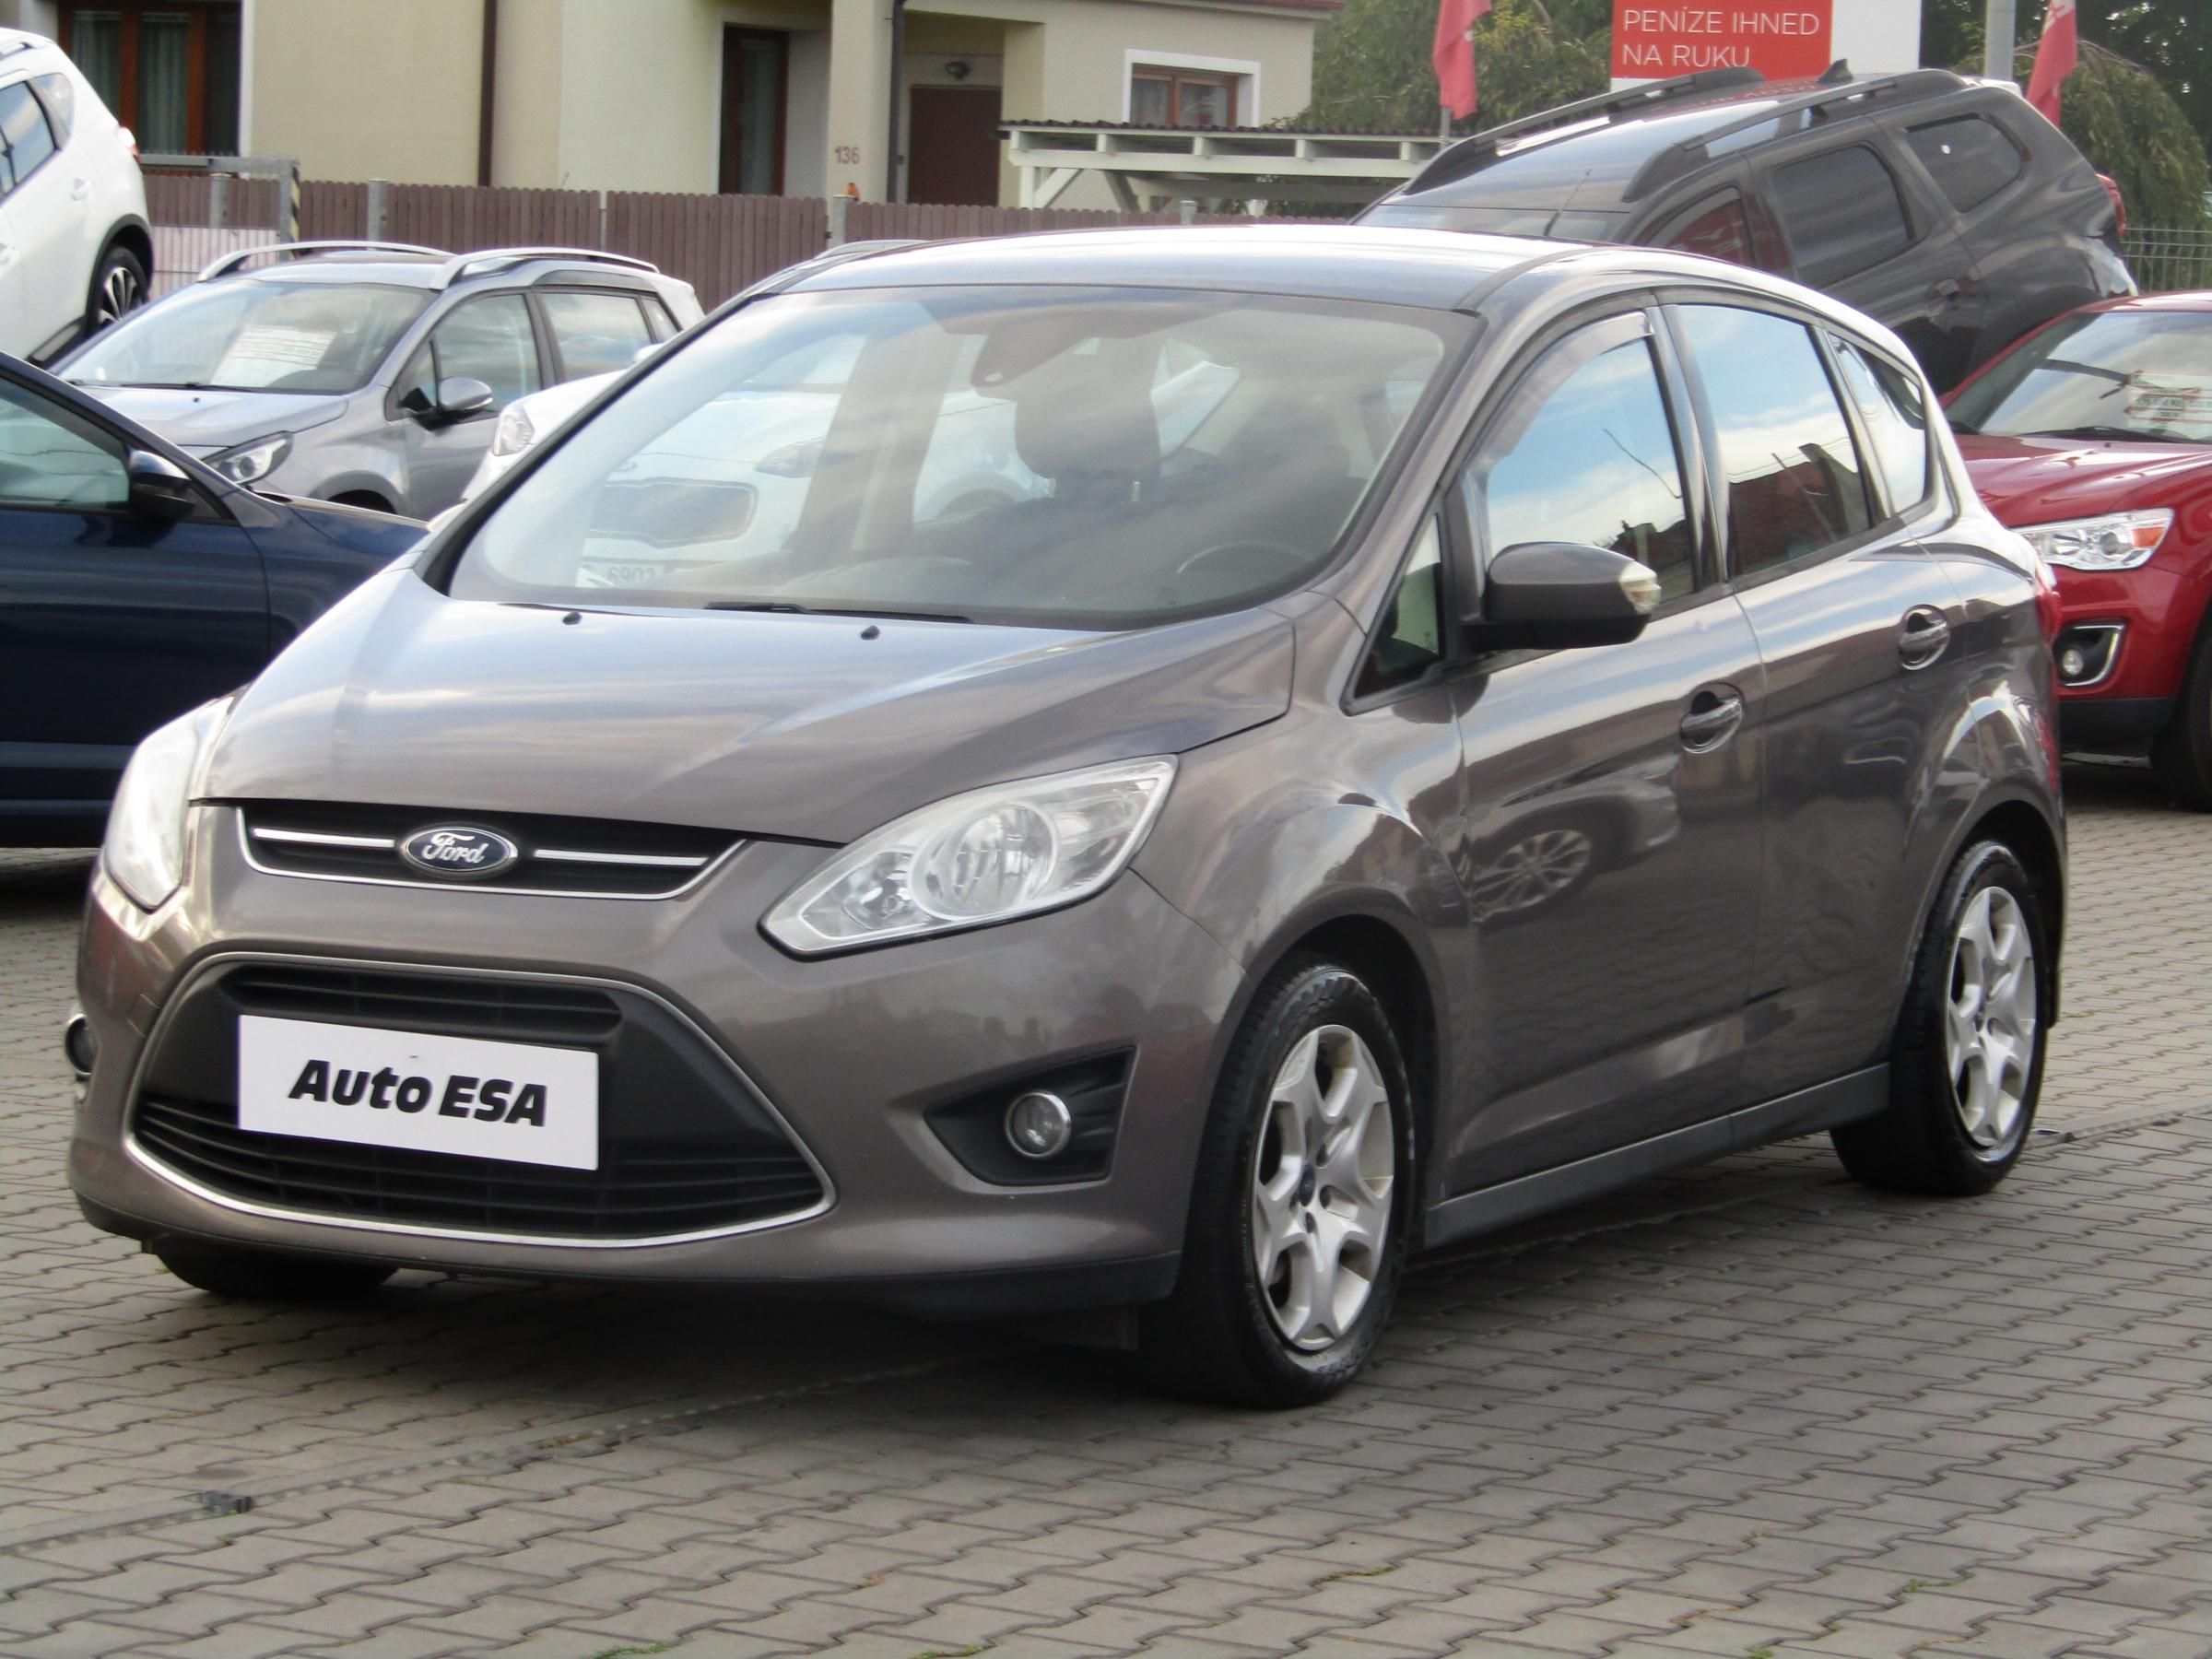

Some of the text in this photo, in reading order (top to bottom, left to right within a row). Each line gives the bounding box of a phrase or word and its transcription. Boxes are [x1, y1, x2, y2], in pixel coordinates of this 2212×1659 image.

[1624, 6, 1819, 35] PENÍZE IHNED
[1623, 44, 1750, 67] NA RUKU
[834, 146, 860, 164] 136
[422, 832, 488, 864] Ford
[288, 1059, 547, 1126] Auto ESA
